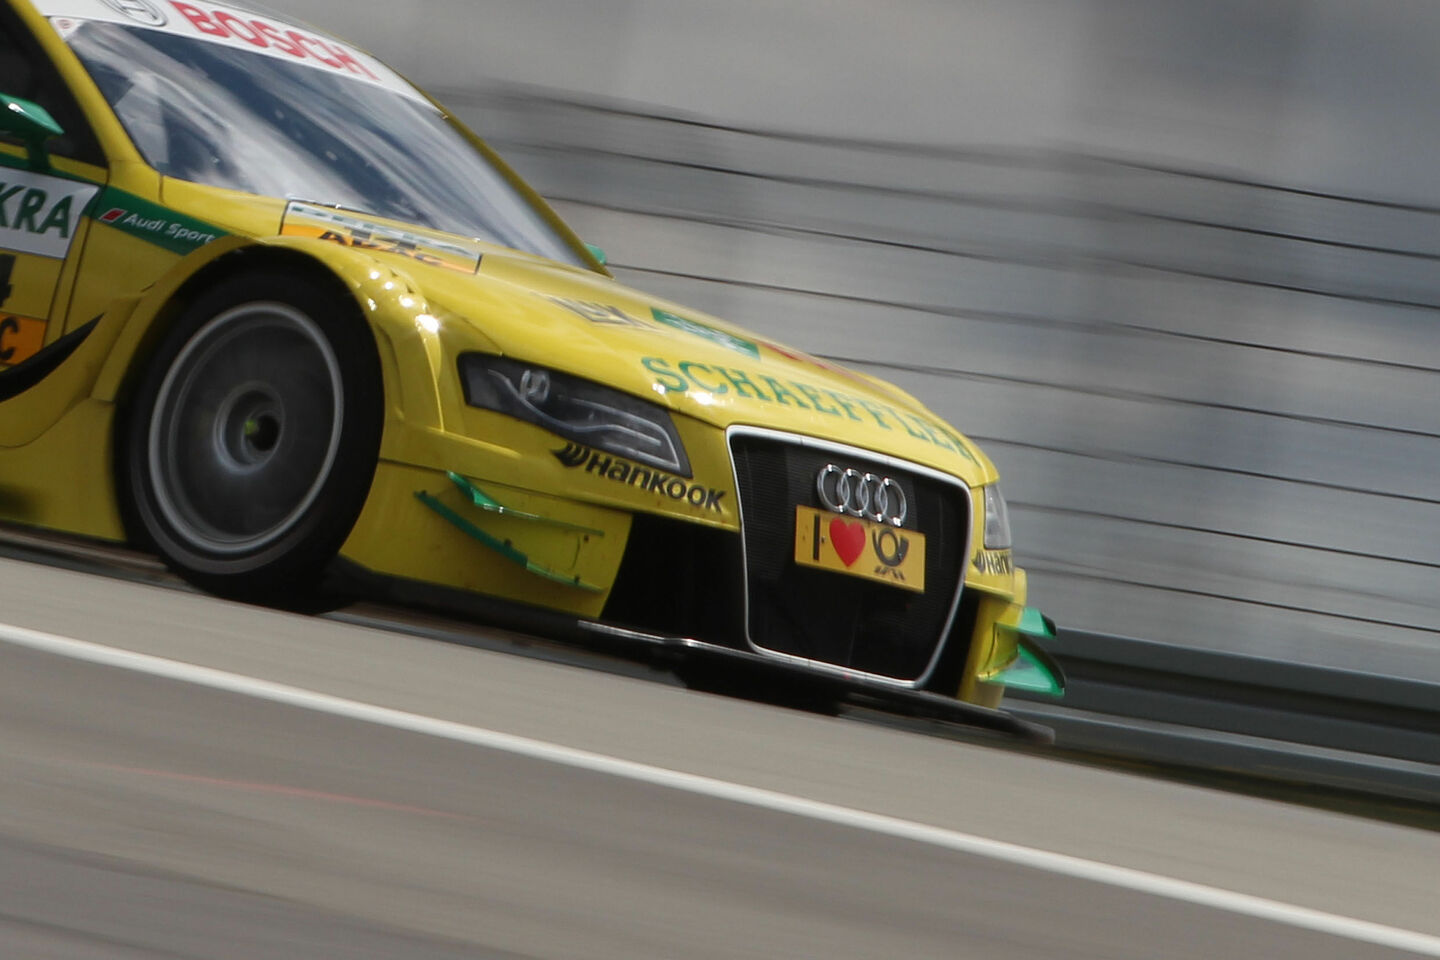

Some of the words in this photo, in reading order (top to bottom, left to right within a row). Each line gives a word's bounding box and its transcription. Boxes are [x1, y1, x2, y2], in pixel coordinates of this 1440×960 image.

[166, 0, 374, 79] BOSCH
[123, 213, 165, 231] Audi
[163, 223, 216, 243] Sport
